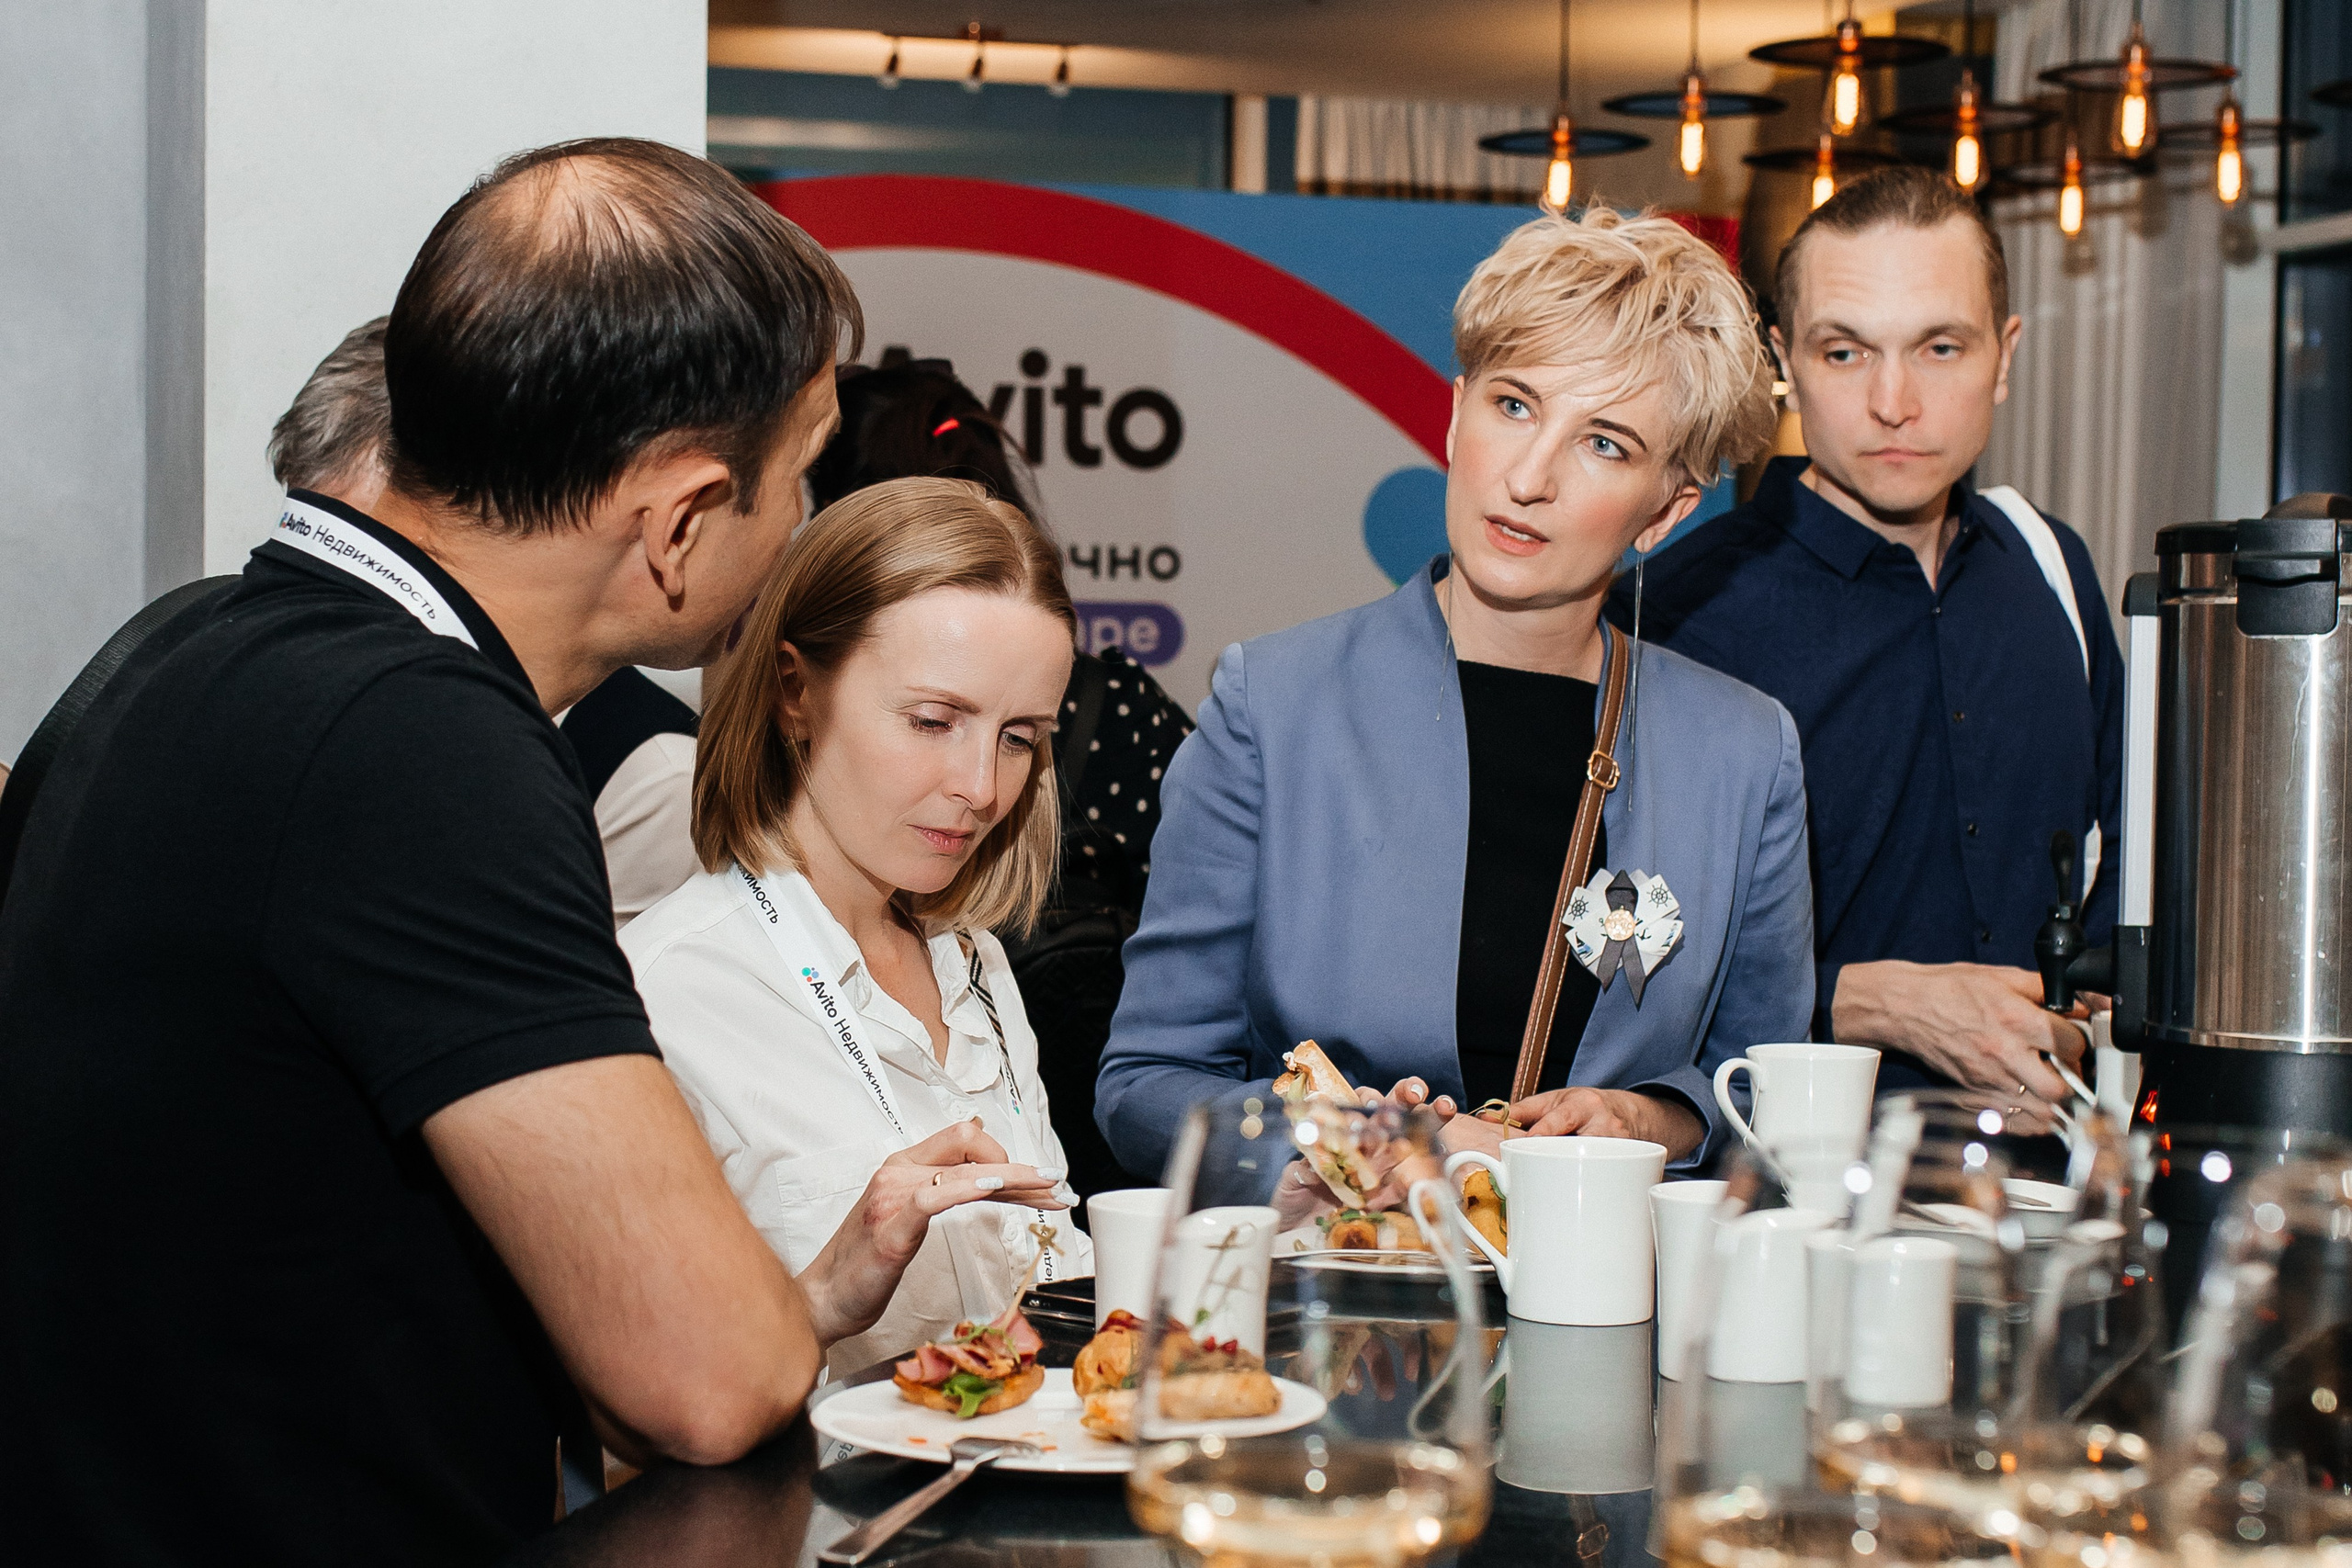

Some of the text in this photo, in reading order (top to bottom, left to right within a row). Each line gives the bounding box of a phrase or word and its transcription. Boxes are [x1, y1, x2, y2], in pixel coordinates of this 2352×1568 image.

[879, 344, 1184, 469] ito
[286, 513, 436, 620] Avito Недвижимость
[1069, 544, 1182, 581] чно
[809, 981, 904, 1134] Avito Недвижимость
